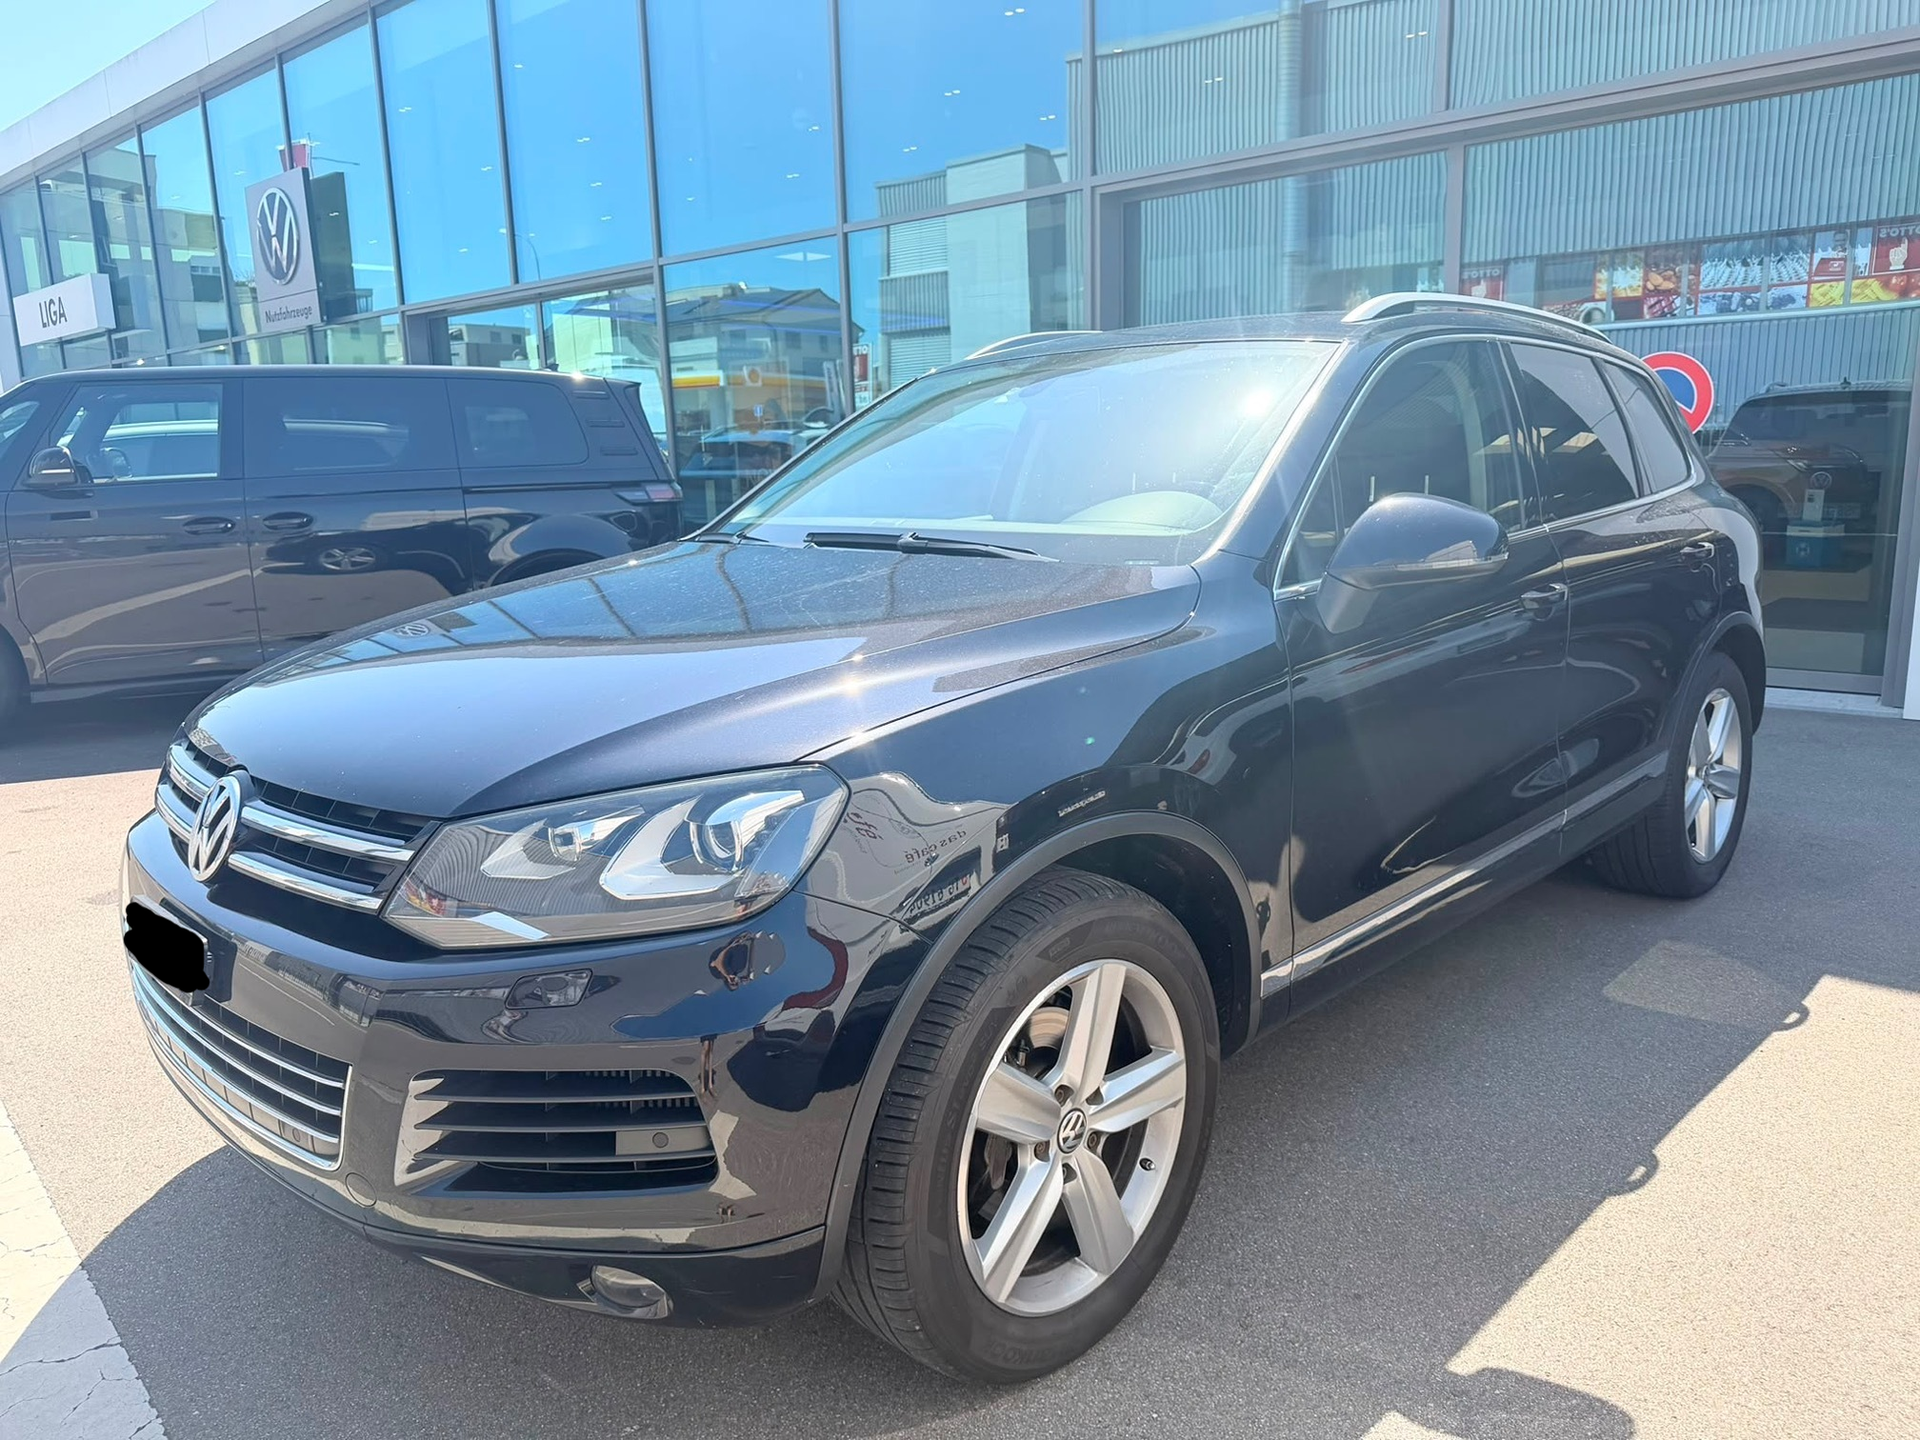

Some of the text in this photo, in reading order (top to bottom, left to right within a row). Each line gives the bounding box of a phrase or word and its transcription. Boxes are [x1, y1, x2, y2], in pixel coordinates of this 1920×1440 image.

[39, 296, 68, 328] LIGA
[264, 305, 313, 323] Nutzfahrzeuge
[188, 775, 241, 882] VW
[1057, 1108, 1087, 1154] VW
